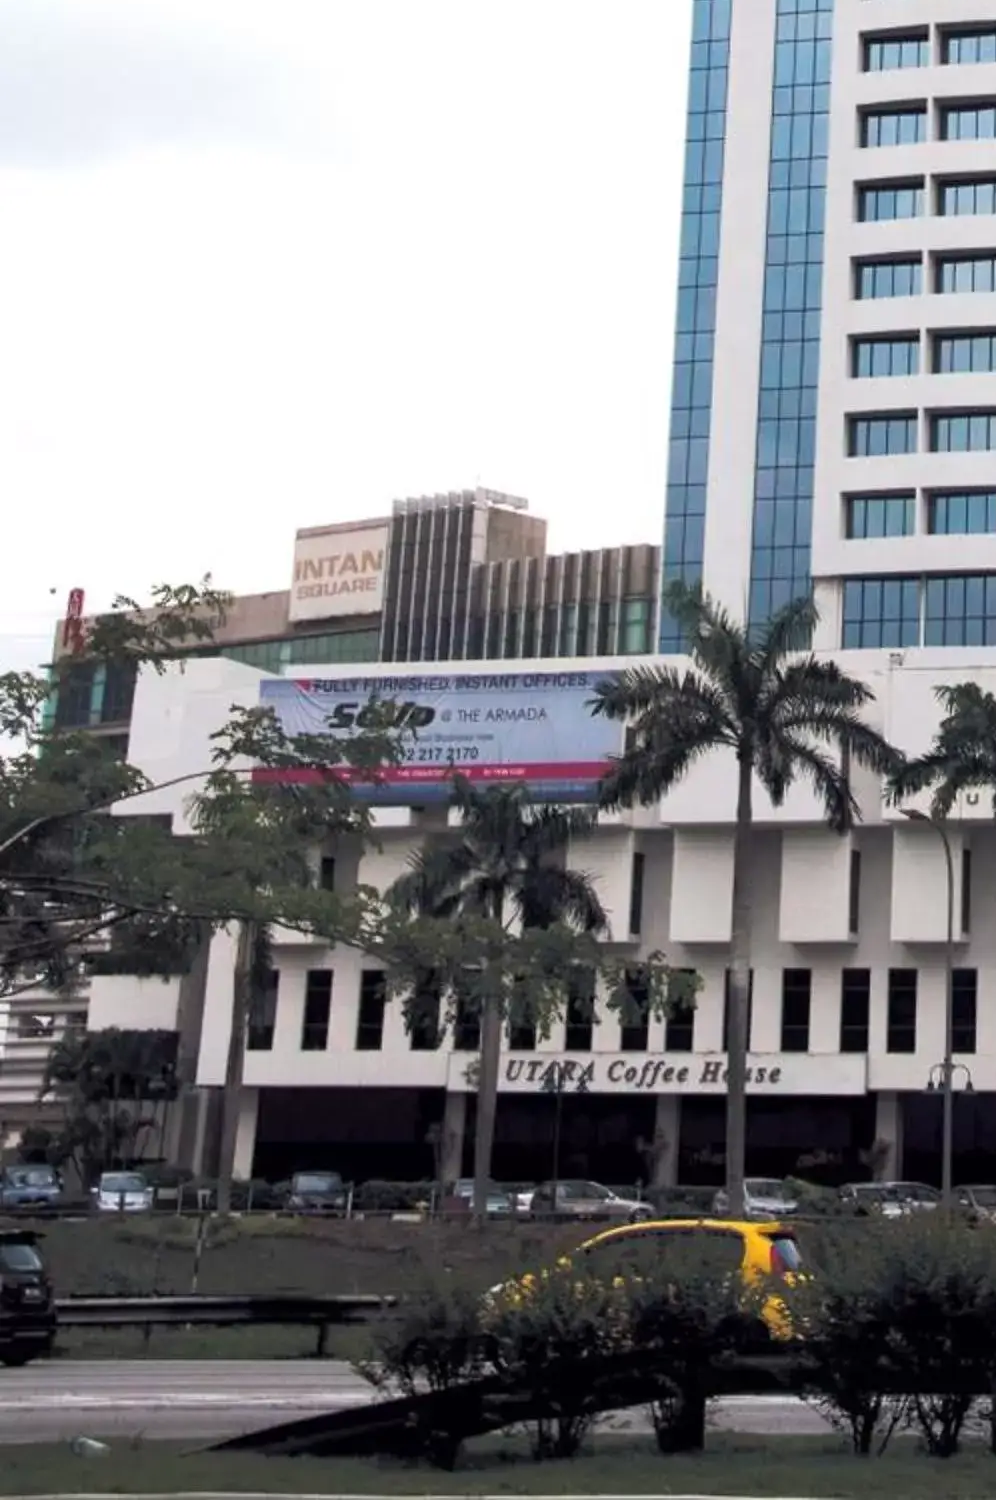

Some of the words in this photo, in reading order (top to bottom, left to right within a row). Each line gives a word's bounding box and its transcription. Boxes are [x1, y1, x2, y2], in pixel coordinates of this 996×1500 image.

[295, 548, 384, 582] INTAN
[296, 577, 377, 600] SQUARE
[313, 678, 360, 693] FULLY
[455, 672, 521, 690] INSTANT
[457, 708, 481, 722] THE
[484, 707, 548, 722] ARMADA
[418, 747, 443, 762] 217
[446, 746, 480, 762] 2170
[505, 1059, 595, 1083] UTARA
[607, 1060, 690, 1088] Coffee
